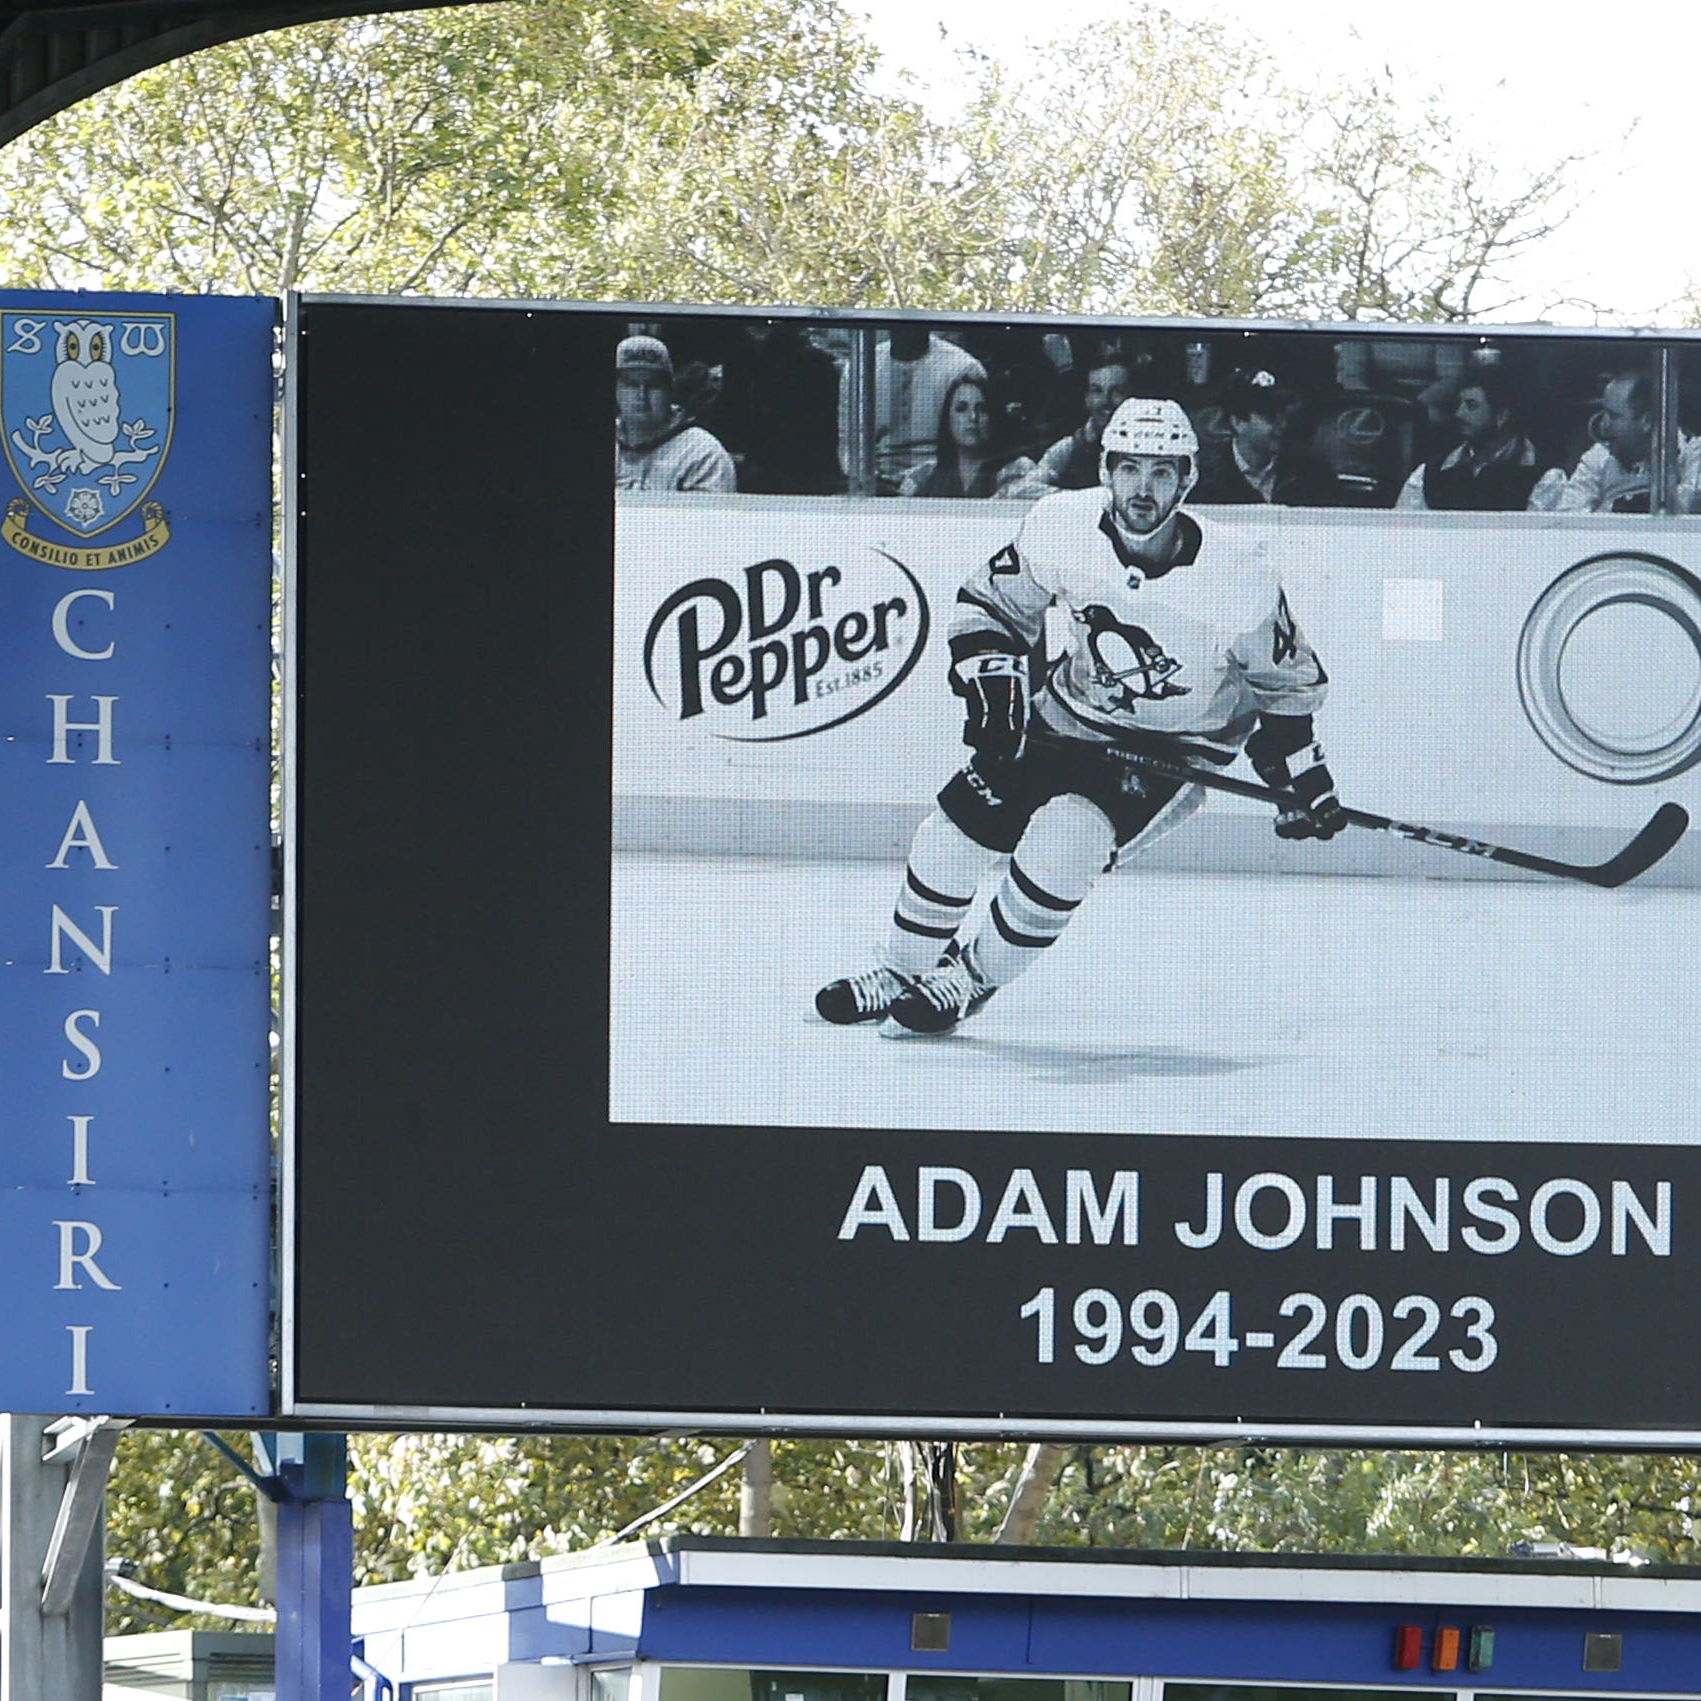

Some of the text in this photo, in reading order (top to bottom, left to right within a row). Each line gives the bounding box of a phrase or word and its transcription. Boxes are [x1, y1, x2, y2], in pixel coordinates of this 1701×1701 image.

[11, 530, 161, 567] CONSILIO ET ANIMIS
[744, 560, 841, 638] Dr
[678, 577, 908, 720] Pepper
[42, 588, 122, 1397] CHANSIRI
[837, 1164, 1673, 1257] ADAM JOHNSON
[1019, 1286, 1499, 1373] 1994-2023
